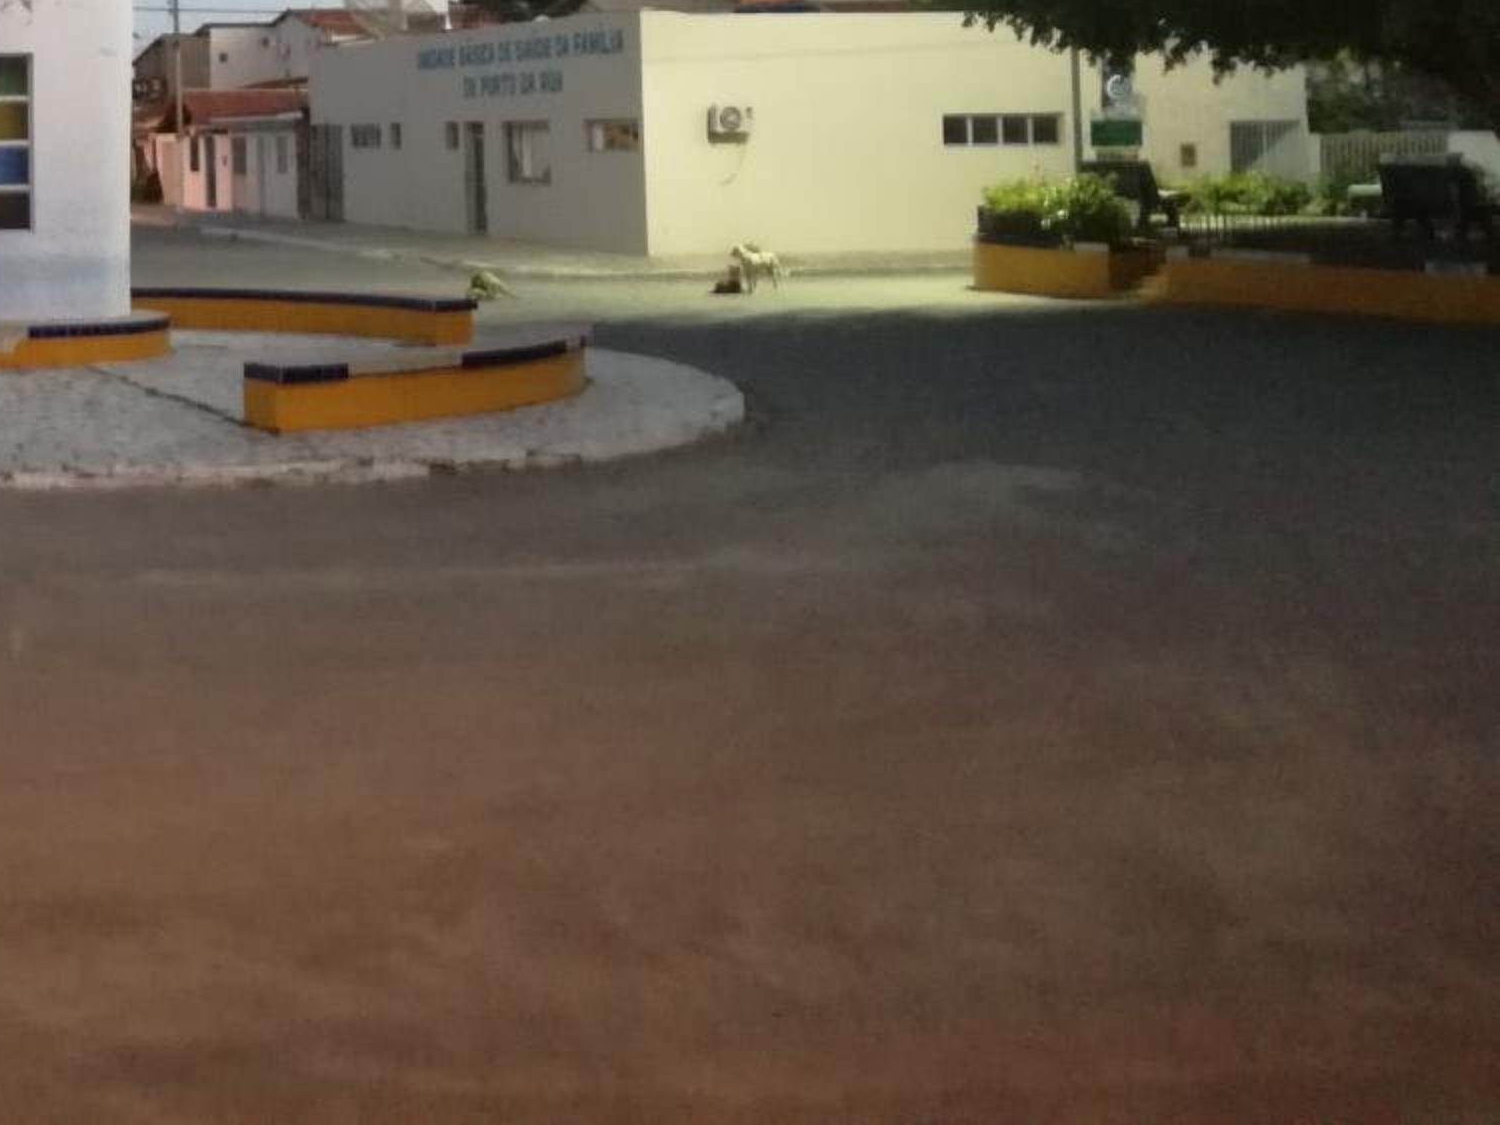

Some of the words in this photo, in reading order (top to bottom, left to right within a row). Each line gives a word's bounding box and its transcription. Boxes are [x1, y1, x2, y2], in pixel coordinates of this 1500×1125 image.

[498, 40, 510, 62] DE
[555, 33, 569, 57] DA
[463, 75, 476, 98] DE
[480, 73, 516, 97] PORTO
[520, 71, 534, 94] DA
[539, 70, 562, 92] RUA
